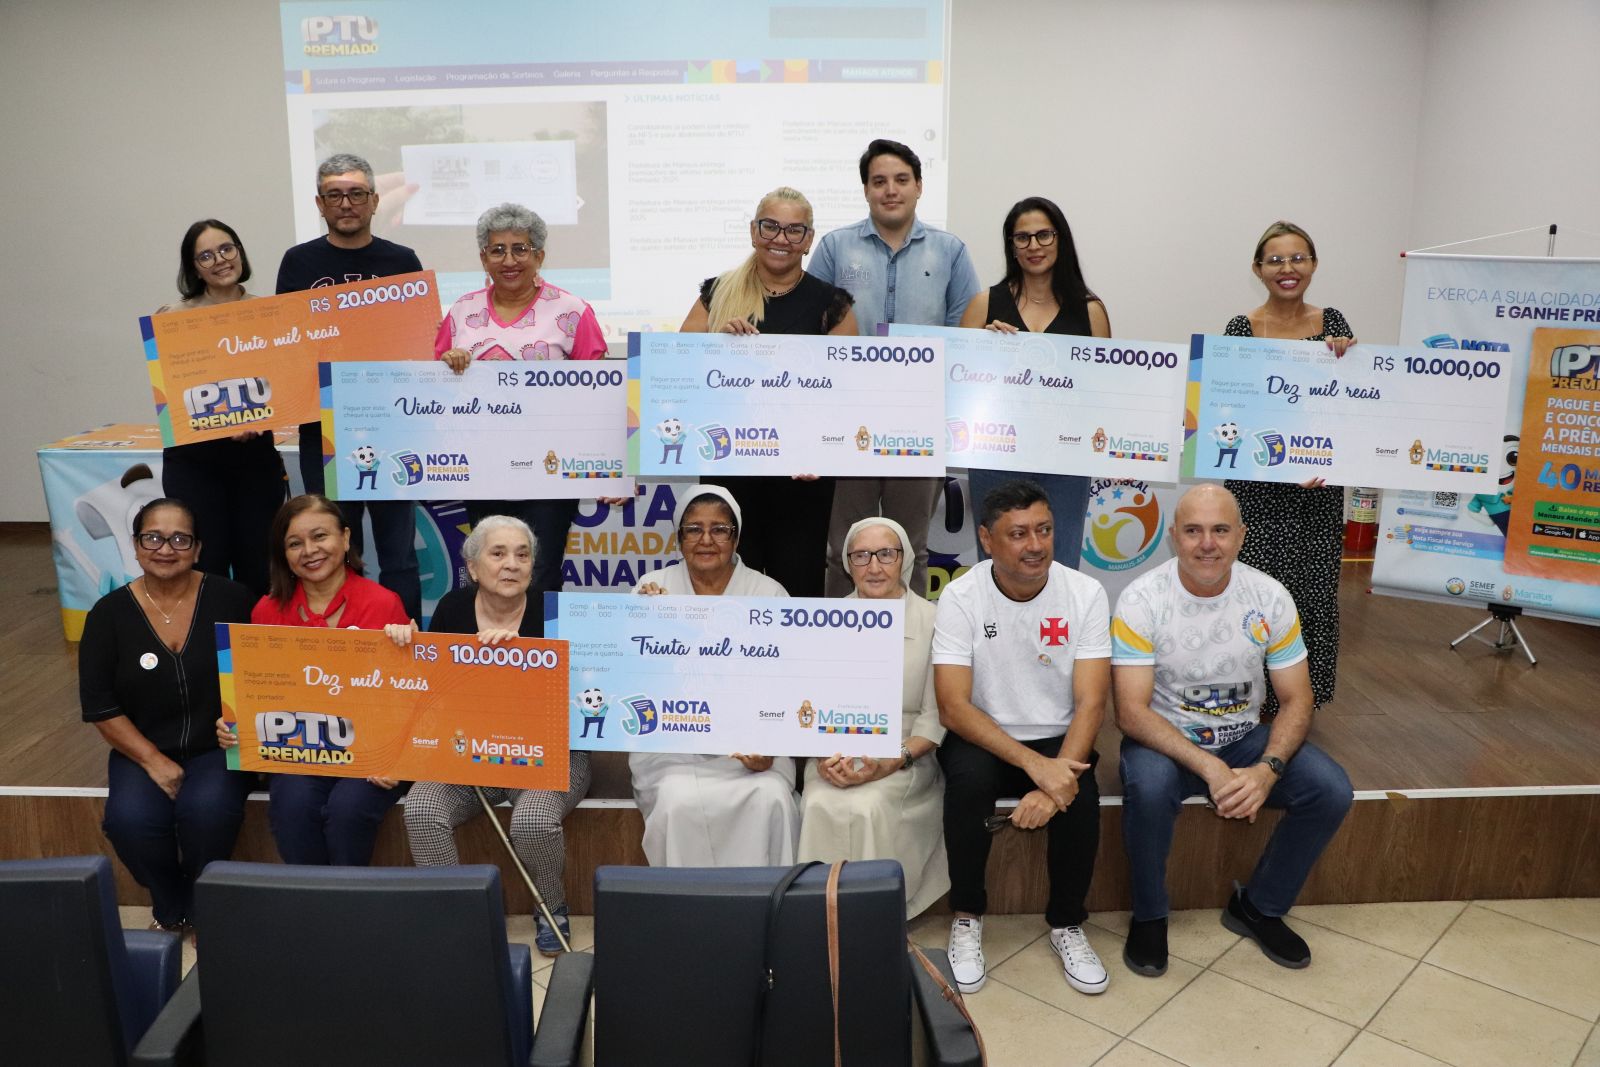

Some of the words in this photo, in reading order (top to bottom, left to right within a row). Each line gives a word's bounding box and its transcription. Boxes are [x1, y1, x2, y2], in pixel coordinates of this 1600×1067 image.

[302, 15, 379, 42] IPTU
[304, 43, 379, 56] PREMIADO
[310, 297, 331, 313] R$
[336, 280, 429, 311] 20.000,00
[1427, 286, 1489, 304] EXERÇA
[1491, 289, 1502, 302] A
[1504, 290, 1537, 305] SUA
[1495, 305, 1505, 318] E
[1508, 305, 1570, 322] GANHE
[218, 334, 268, 356] Vinte
[273, 326, 302, 346] mil
[306, 325, 340, 341] reais
[827, 346, 848, 361] R$
[850, 346, 935, 366] 5.000,00
[1070, 346, 1092, 363] R$
[1094, 347, 1178, 371] 5.000,00
[1373, 355, 1395, 372] R$
[1404, 356, 1501, 381] 10.000,00
[497, 371, 519, 387] R$
[524, 370, 624, 391] 20.000,00
[706, 369, 755, 390] Cinco
[761, 370, 791, 389] mil
[797, 375, 833, 390] reais
[950, 363, 997, 384] Cinco
[1003, 368, 1033, 387] mil
[1038, 372, 1075, 390] reais
[183, 376, 273, 416] IPTU
[1266, 375, 1302, 404] Dez
[1309, 379, 1340, 398] mil
[1346, 383, 1381, 401] reais
[394, 396, 446, 417] Vinte
[452, 397, 482, 416] mil
[487, 400, 523, 416] reais
[1547, 397, 1591, 412] PAGUE
[188, 406, 275, 432] PREMIADO
[1545, 411, 1554, 424] E
[734, 427, 779, 440] NOTA
[973, 421, 1017, 437] NOTA
[1543, 427, 1555, 441] A
[734, 440, 780, 448] PREMIADA
[821, 434, 845, 442] Semef
[872, 433, 934, 448] Manaus
[1058, 434, 1082, 443] Semef
[1108, 436, 1169, 454] Manaus
[1290, 434, 1333, 450] NOTA
[734, 448, 780, 457] MANAUS
[973, 442, 1017, 454] MANAUS
[1289, 447, 1333, 459] PREMIADA
[1375, 447, 1399, 456] Semef
[1541, 443, 1592, 457] MENSAIS
[426, 453, 469, 466] NOTA
[510, 459, 533, 468] Semef
[561, 456, 624, 471] Manaus
[1288, 456, 1333, 467] MANAUS
[1426, 448, 1489, 466] Manaus
[426, 466, 470, 474] PREMIADA
[426, 473, 470, 482] MANAUS
[1537, 460, 1582, 492] 40
[571, 484, 677, 528] OTA
[1538, 512, 1565, 520] Manaus
[1566, 515, 1592, 523] Atende
[1544, 528, 1561, 536] Google
[565, 531, 679, 556] EMIADA
[1470, 581, 1496, 590] SEMEF
[1515, 588, 1553, 602] Manaus
[749, 608, 773, 625] R$
[780, 608, 893, 632] 30.000,00
[631, 635, 691, 657] Trinta
[699, 637, 733, 658] mil
[740, 641, 780, 659] reais
[413, 644, 438, 661] R$
[449, 644, 558, 671] 10.000,00
[581, 665, 610, 673] portador
[302, 665, 344, 695] Dez
[350, 669, 383, 688] mil
[389, 674, 429, 692] reais
[661, 700, 711, 715] NOTA
[759, 710, 785, 719] Semef
[661, 714, 711, 723] PREMIADA
[818, 709, 889, 726] Manaus
[255, 710, 356, 748] IPTU
[661, 722, 712, 734] MANAUS
[1218, 726, 1253, 738] PREMIADA
[412, 736, 439, 746] Semef
[471, 738, 544, 757] Manaus
[257, 745, 355, 764] PREMIADO
